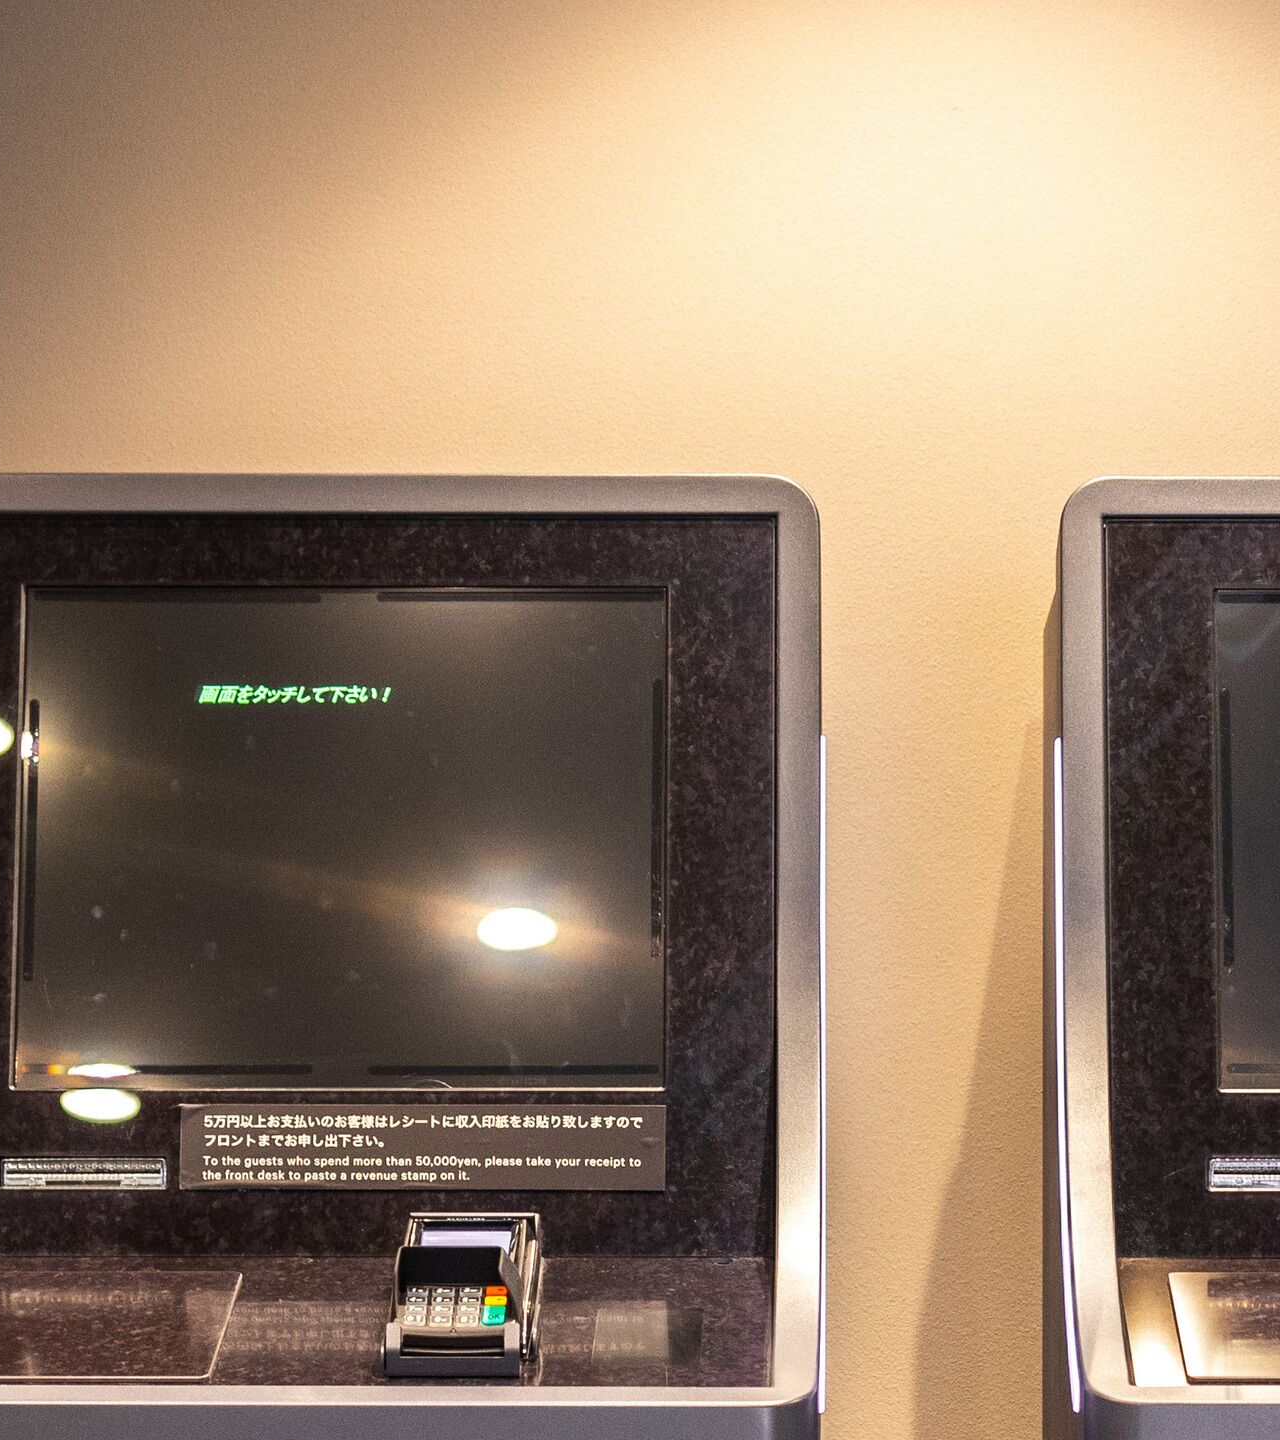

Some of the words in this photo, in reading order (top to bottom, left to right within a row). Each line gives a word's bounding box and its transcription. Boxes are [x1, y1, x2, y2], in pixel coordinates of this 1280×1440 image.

[198, 684, 393, 705] 画面をタッチして下さい！
[203, 1113, 644, 1129] 5万円以上お支払いのお客様はレシートに収入印紙をお貼り致しますので
[203, 1133, 385, 1149] フロントまでお申し出下さい。
[202, 1155, 219, 1167] To
[221, 1155, 242, 1167] the
[244, 1155, 284, 1169] guests
[286, 1155, 311, 1167] who
[313, 1155, 350, 1169] spend
[352, 1157, 383, 1167] more
[385, 1155, 413, 1167] than
[415, 1155, 482, 1169] 50,000yen,
[484, 1155, 523, 1169] please
[525, 1155, 552, 1167] take
[554, 1158, 582, 1170] your
[584, 1156, 626, 1170] receipt
[628, 1157, 642, 1168] to
[201, 1169, 221, 1181] the
[223, 1169, 255, 1181] front
[257, 1169, 285, 1181] desk
[286, 1170, 301, 1181] to
[303, 1171, 337, 1185] paste
[339, 1172, 348, 1181] a
[350, 1172, 398, 1181] revenue
[400, 1170, 438, 1185] stamp
[439, 1172, 456, 1181] on
[458, 1169, 471, 1181] it.
